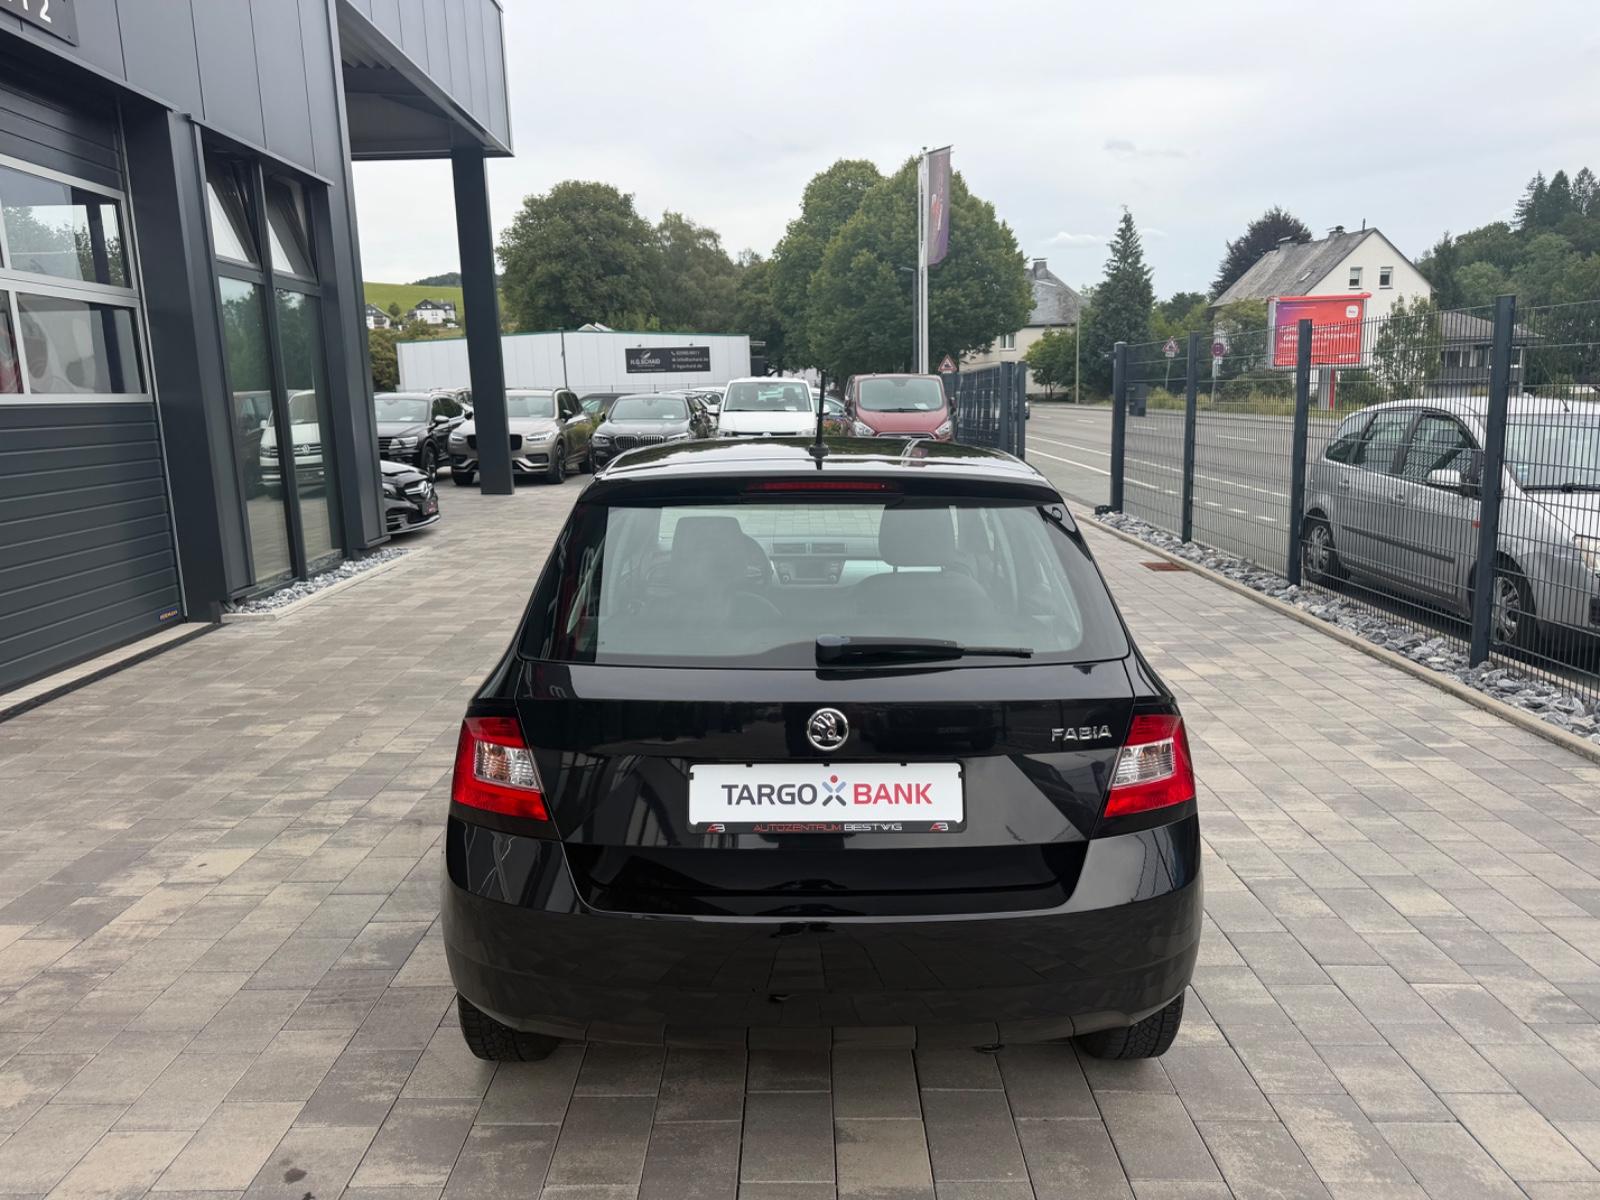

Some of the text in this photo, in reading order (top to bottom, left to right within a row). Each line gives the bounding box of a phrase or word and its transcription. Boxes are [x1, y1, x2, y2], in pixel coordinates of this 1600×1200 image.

[1051, 725, 1112, 742] FABIA
[721, 783, 933, 805] TARGO BANK
[753, 823, 903, 832] AUTOZENTRUM BESTWIG
